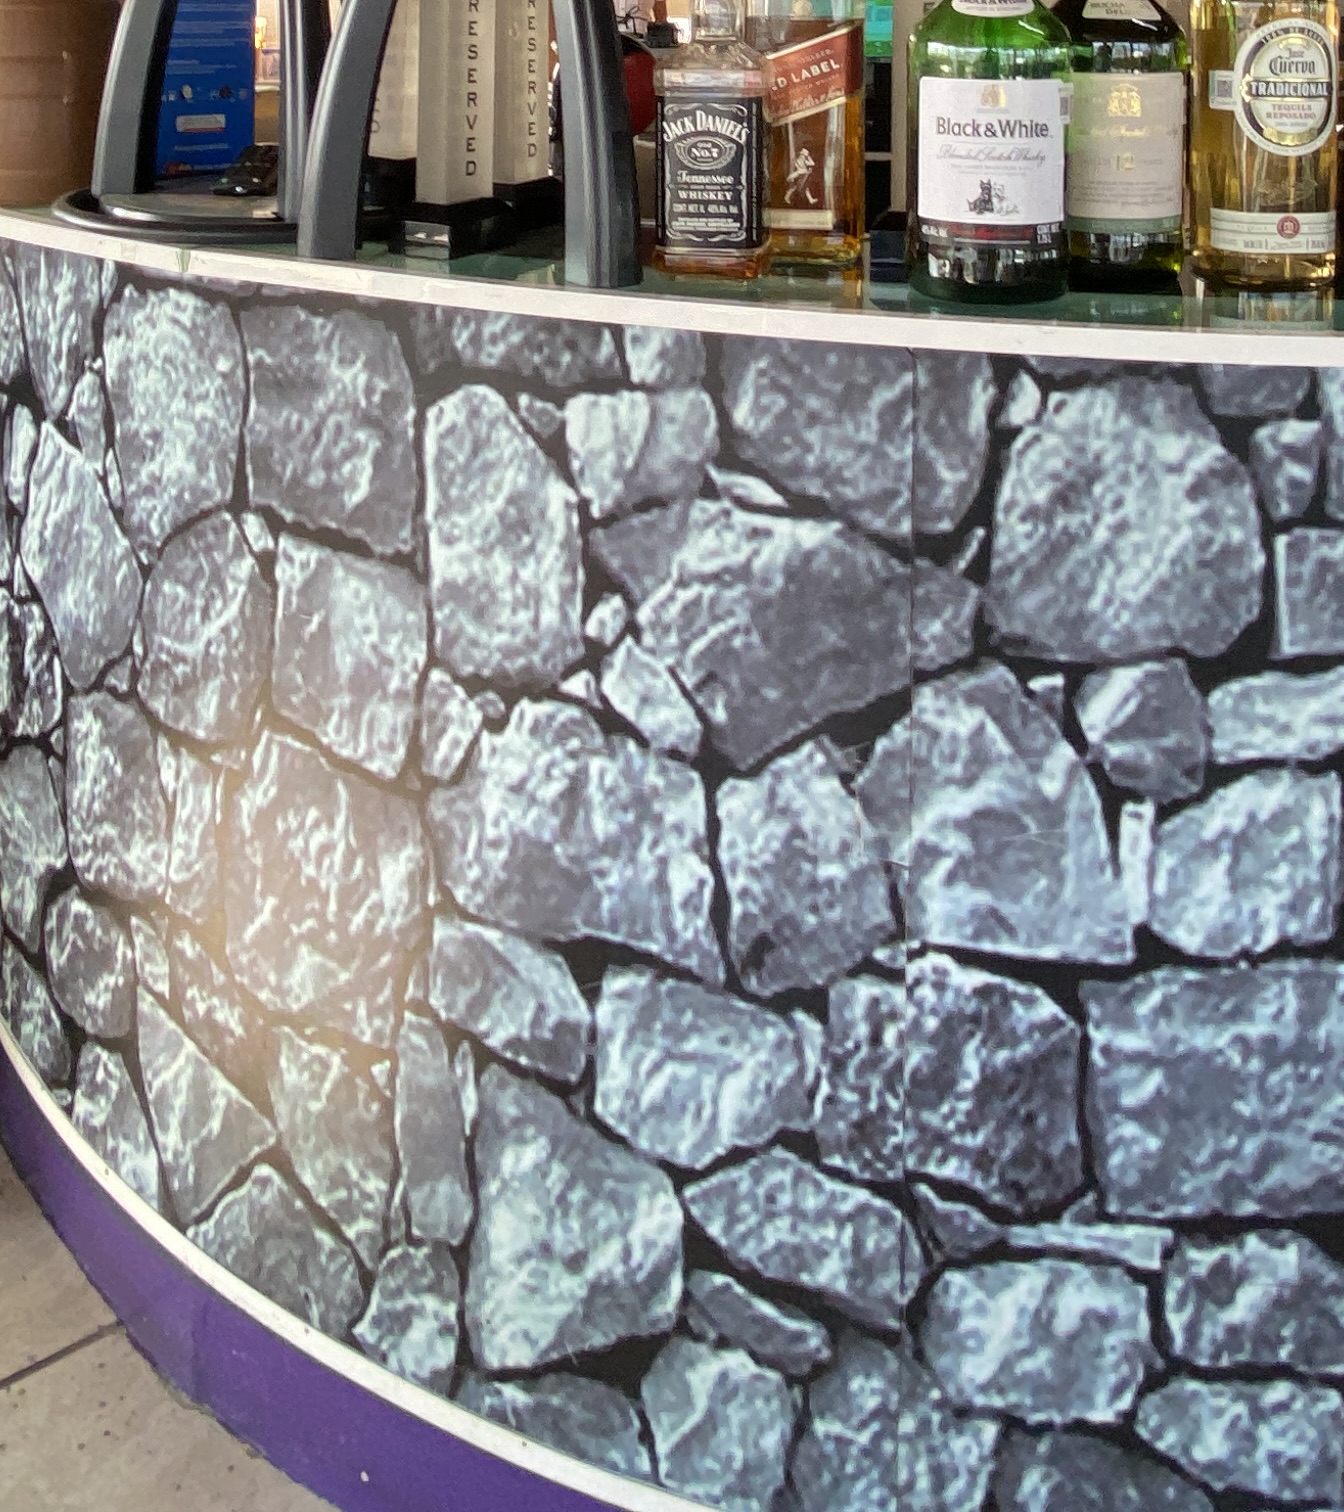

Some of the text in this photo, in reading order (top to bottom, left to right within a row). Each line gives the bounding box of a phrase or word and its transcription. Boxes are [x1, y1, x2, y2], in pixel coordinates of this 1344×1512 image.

[791, 59, 841, 83] LABEL
[1268, 55, 1316, 76] Cuervo
[1250, 81, 1329, 96] TRADICIONAL
[662, 116, 696, 142] JACK
[676, 170, 734, 185] Tennessee
[677, 189, 734, 201] WHISKEY
